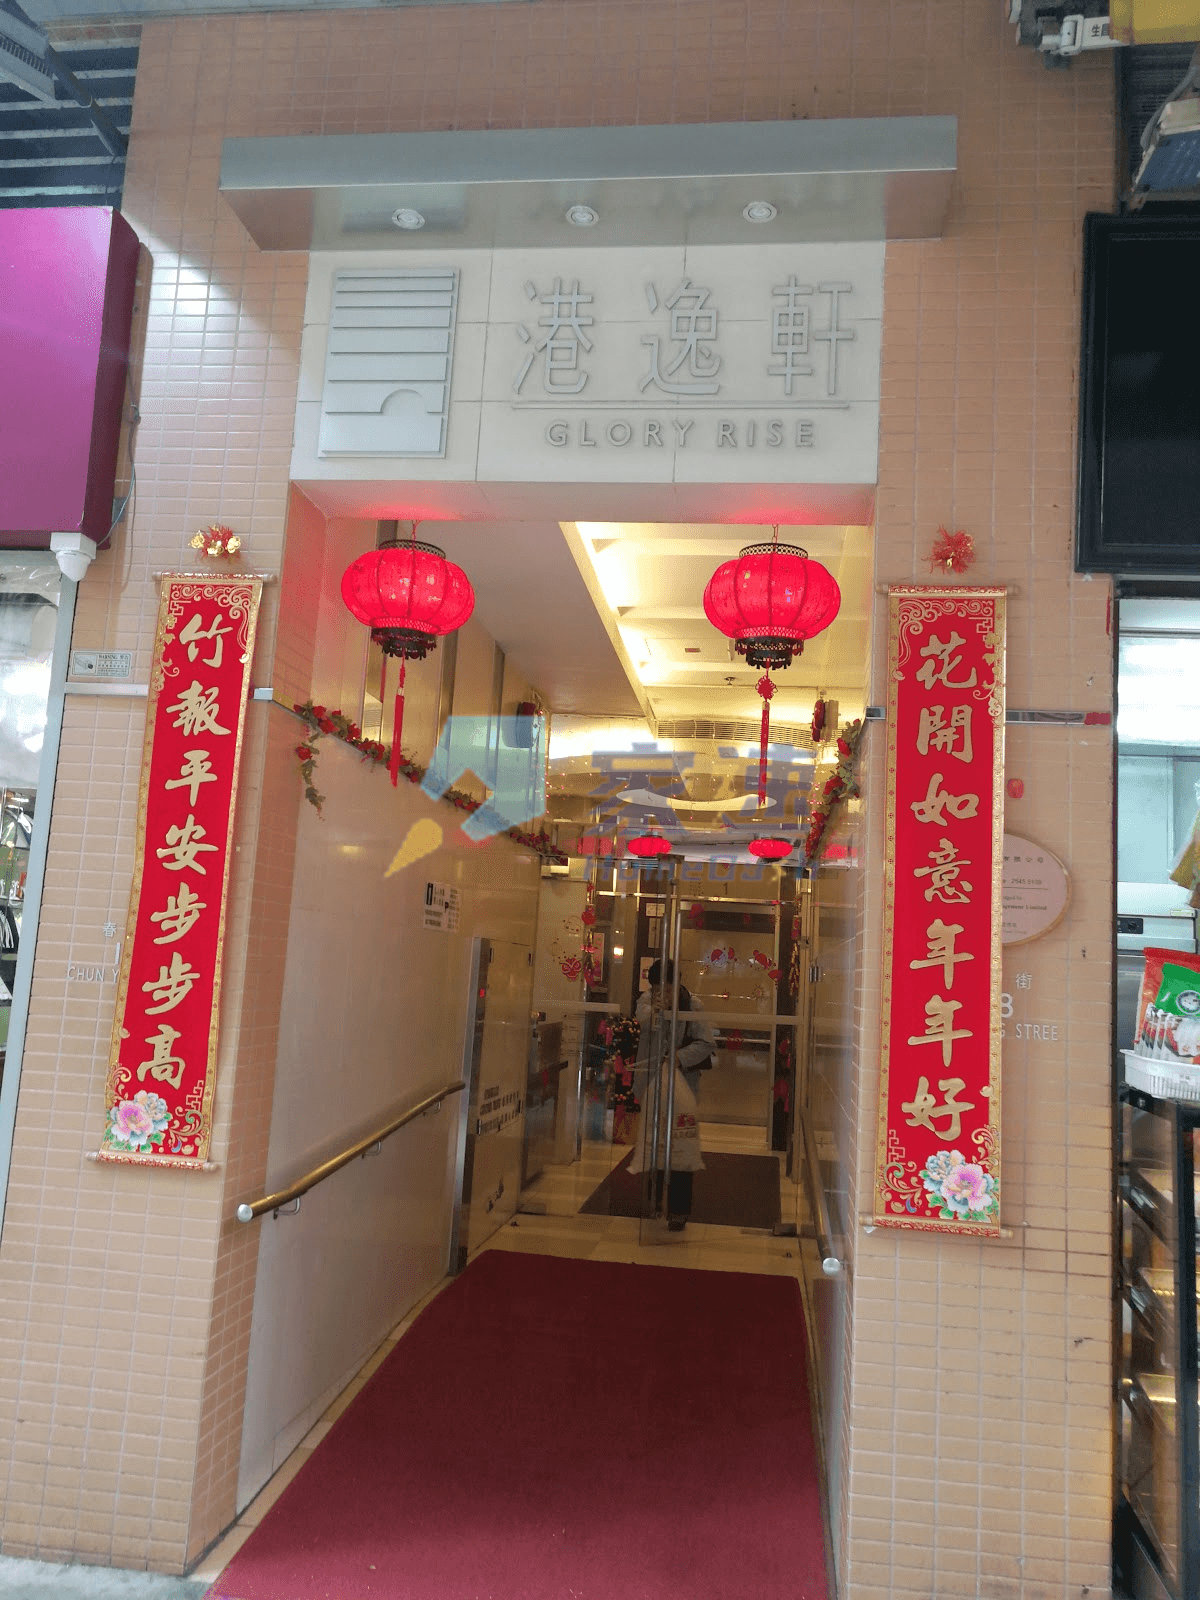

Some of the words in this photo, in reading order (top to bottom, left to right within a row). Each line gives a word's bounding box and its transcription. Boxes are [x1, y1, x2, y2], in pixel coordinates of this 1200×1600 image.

[512, 276, 855, 396] 港逸軒
[545, 419, 694, 448] GLORY
[715, 419, 815, 448] RISE
[137, 613, 233, 1090] 竹報平安步步高
[901, 630, 980, 1142] 花開如意年年好
[67, 966, 105, 982] CHUN
[1015, 973, 1033, 990] 街
[1015, 1022, 1059, 1041] STREE
